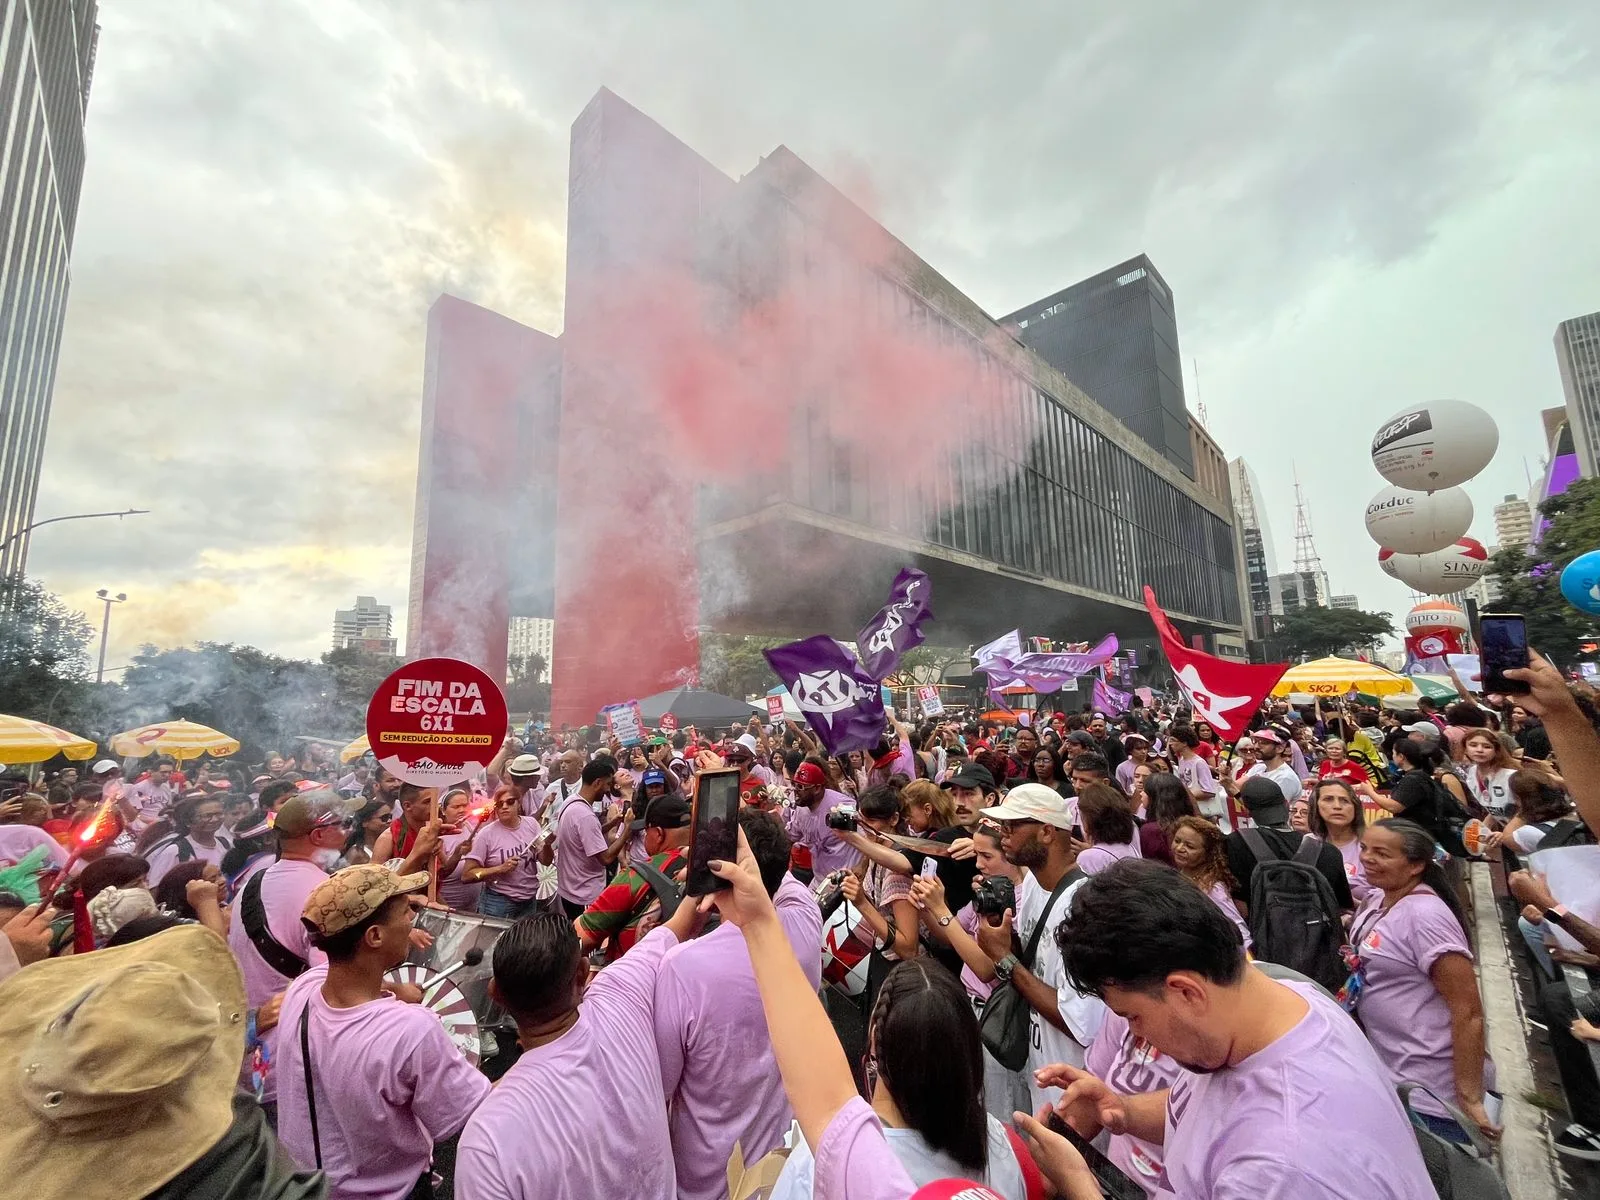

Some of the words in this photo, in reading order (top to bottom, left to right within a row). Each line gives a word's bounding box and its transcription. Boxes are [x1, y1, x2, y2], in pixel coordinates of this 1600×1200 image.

[397, 678, 443, 697] FIM
[449, 682, 482, 699] DA
[808, 681, 838, 706] PT
[1307, 684, 1339, 694] SKOL
[390, 696, 486, 716] ESCALA
[420, 714, 454, 732] 6X1
[383, 734, 400, 742] SEM
[401, 734, 440, 744] REDUÇÃO
[441, 736, 453, 744] DO
[454, 736, 489, 744] SALÁRIO
[500, 843, 530, 865] LUN
